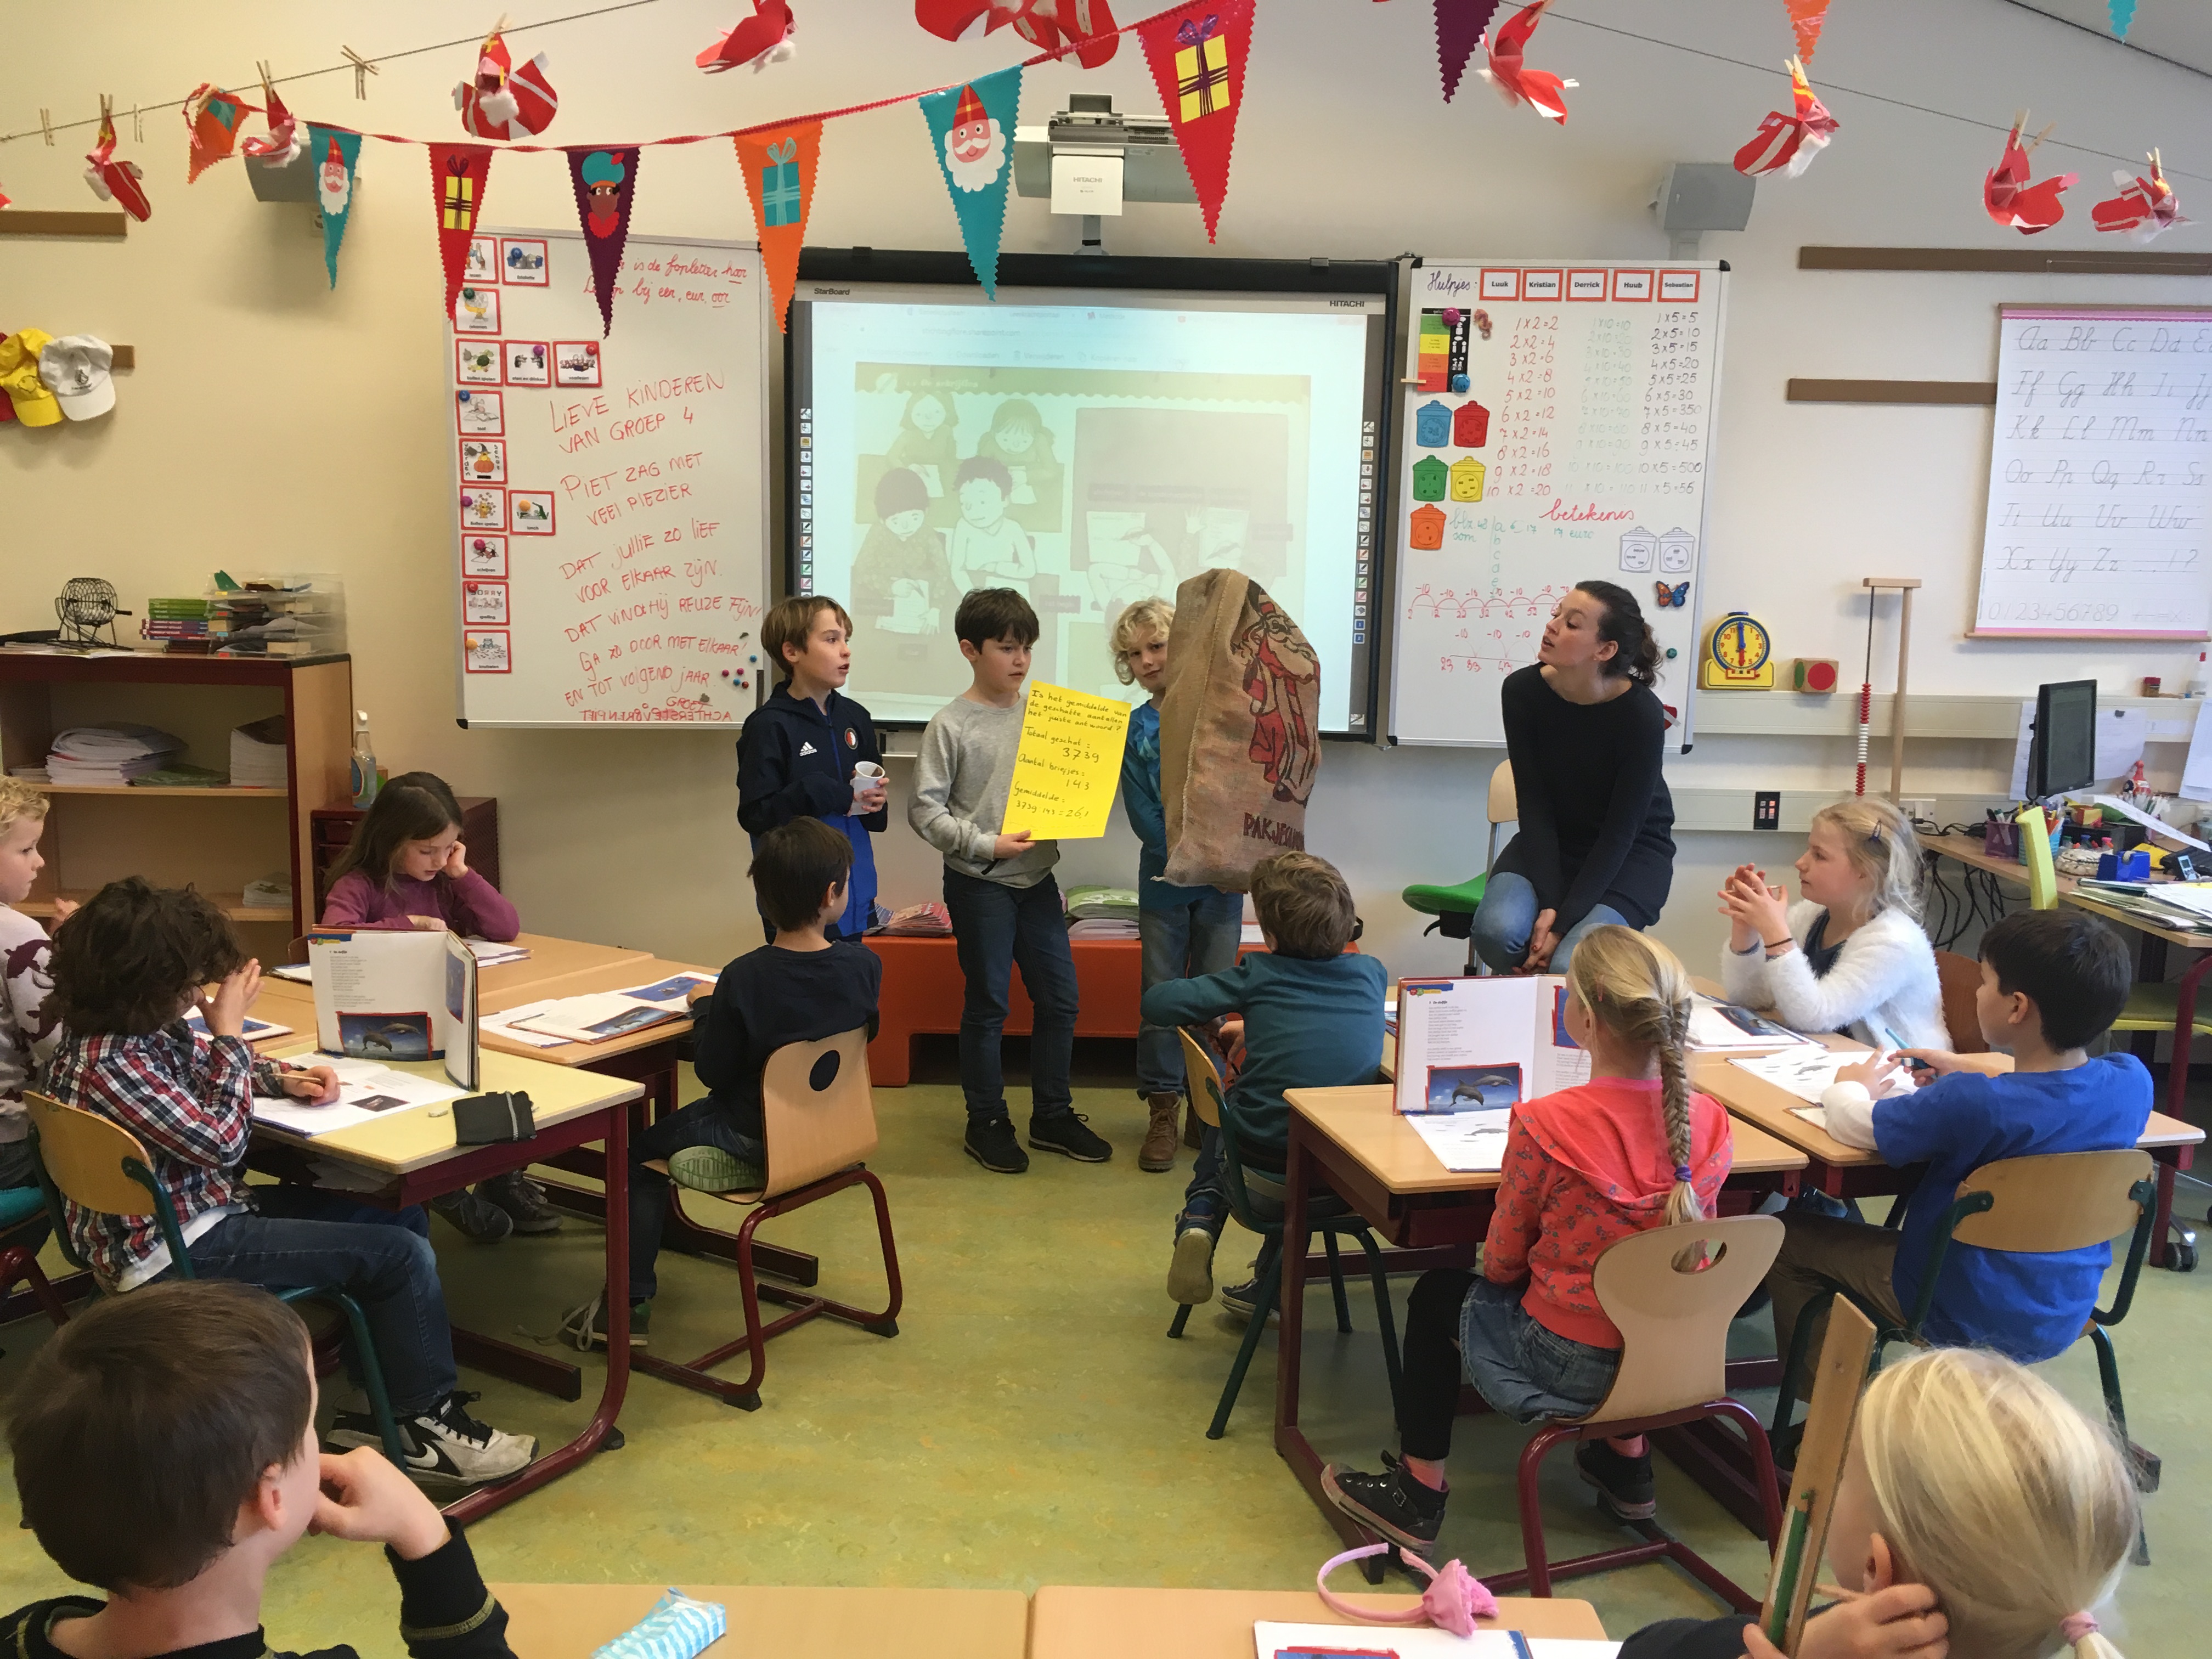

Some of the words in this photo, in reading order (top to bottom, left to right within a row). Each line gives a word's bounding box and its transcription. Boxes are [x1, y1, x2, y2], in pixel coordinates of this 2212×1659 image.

[648, 258, 661, 272] de
[814, 287, 850, 296] StarBoard
[1528, 280, 1556, 289] Kristian
[1329, 300, 1365, 308] HITACHI
[559, 426, 600, 453] VAN
[610, 413, 665, 440] GROEP
[683, 407, 693, 424] 4
[626, 462, 661, 482] ZAG
[669, 452, 703, 471] MET
[1539, 498, 1634, 521] betekenis
[1570, 530, 1594, 539] euro
[559, 551, 601, 579] DAT
[664, 527, 682, 543] ZO
[575, 578, 611, 603] VOOR
[564, 614, 602, 642] DAT
[679, 596, 723, 612] REUZE
[579, 652, 600, 681] GA
[608, 645, 622, 659] ZO
[630, 634, 662, 653] DOOR
[668, 636, 697, 650] MET
[565, 689, 584, 707] EN
[588, 677, 612, 697] TOT
[1029, 699, 1039, 708] de
[1043, 704, 1081, 717] geschatte
[1087, 713, 1123, 724] aantallen
[1048, 692, 1063, 703] het
[1066, 699, 1109, 713] gemiddelde
[1028, 709, 1042, 717] het
[1047, 713, 1071, 724] juiste
[1024, 726, 1048, 740] Totaal
[1050, 736, 1081, 746] geschat
[1018, 753, 1044, 768] Aantal
[1062, 747, 1099, 763] 3739
[1065, 779, 1090, 790] 143
